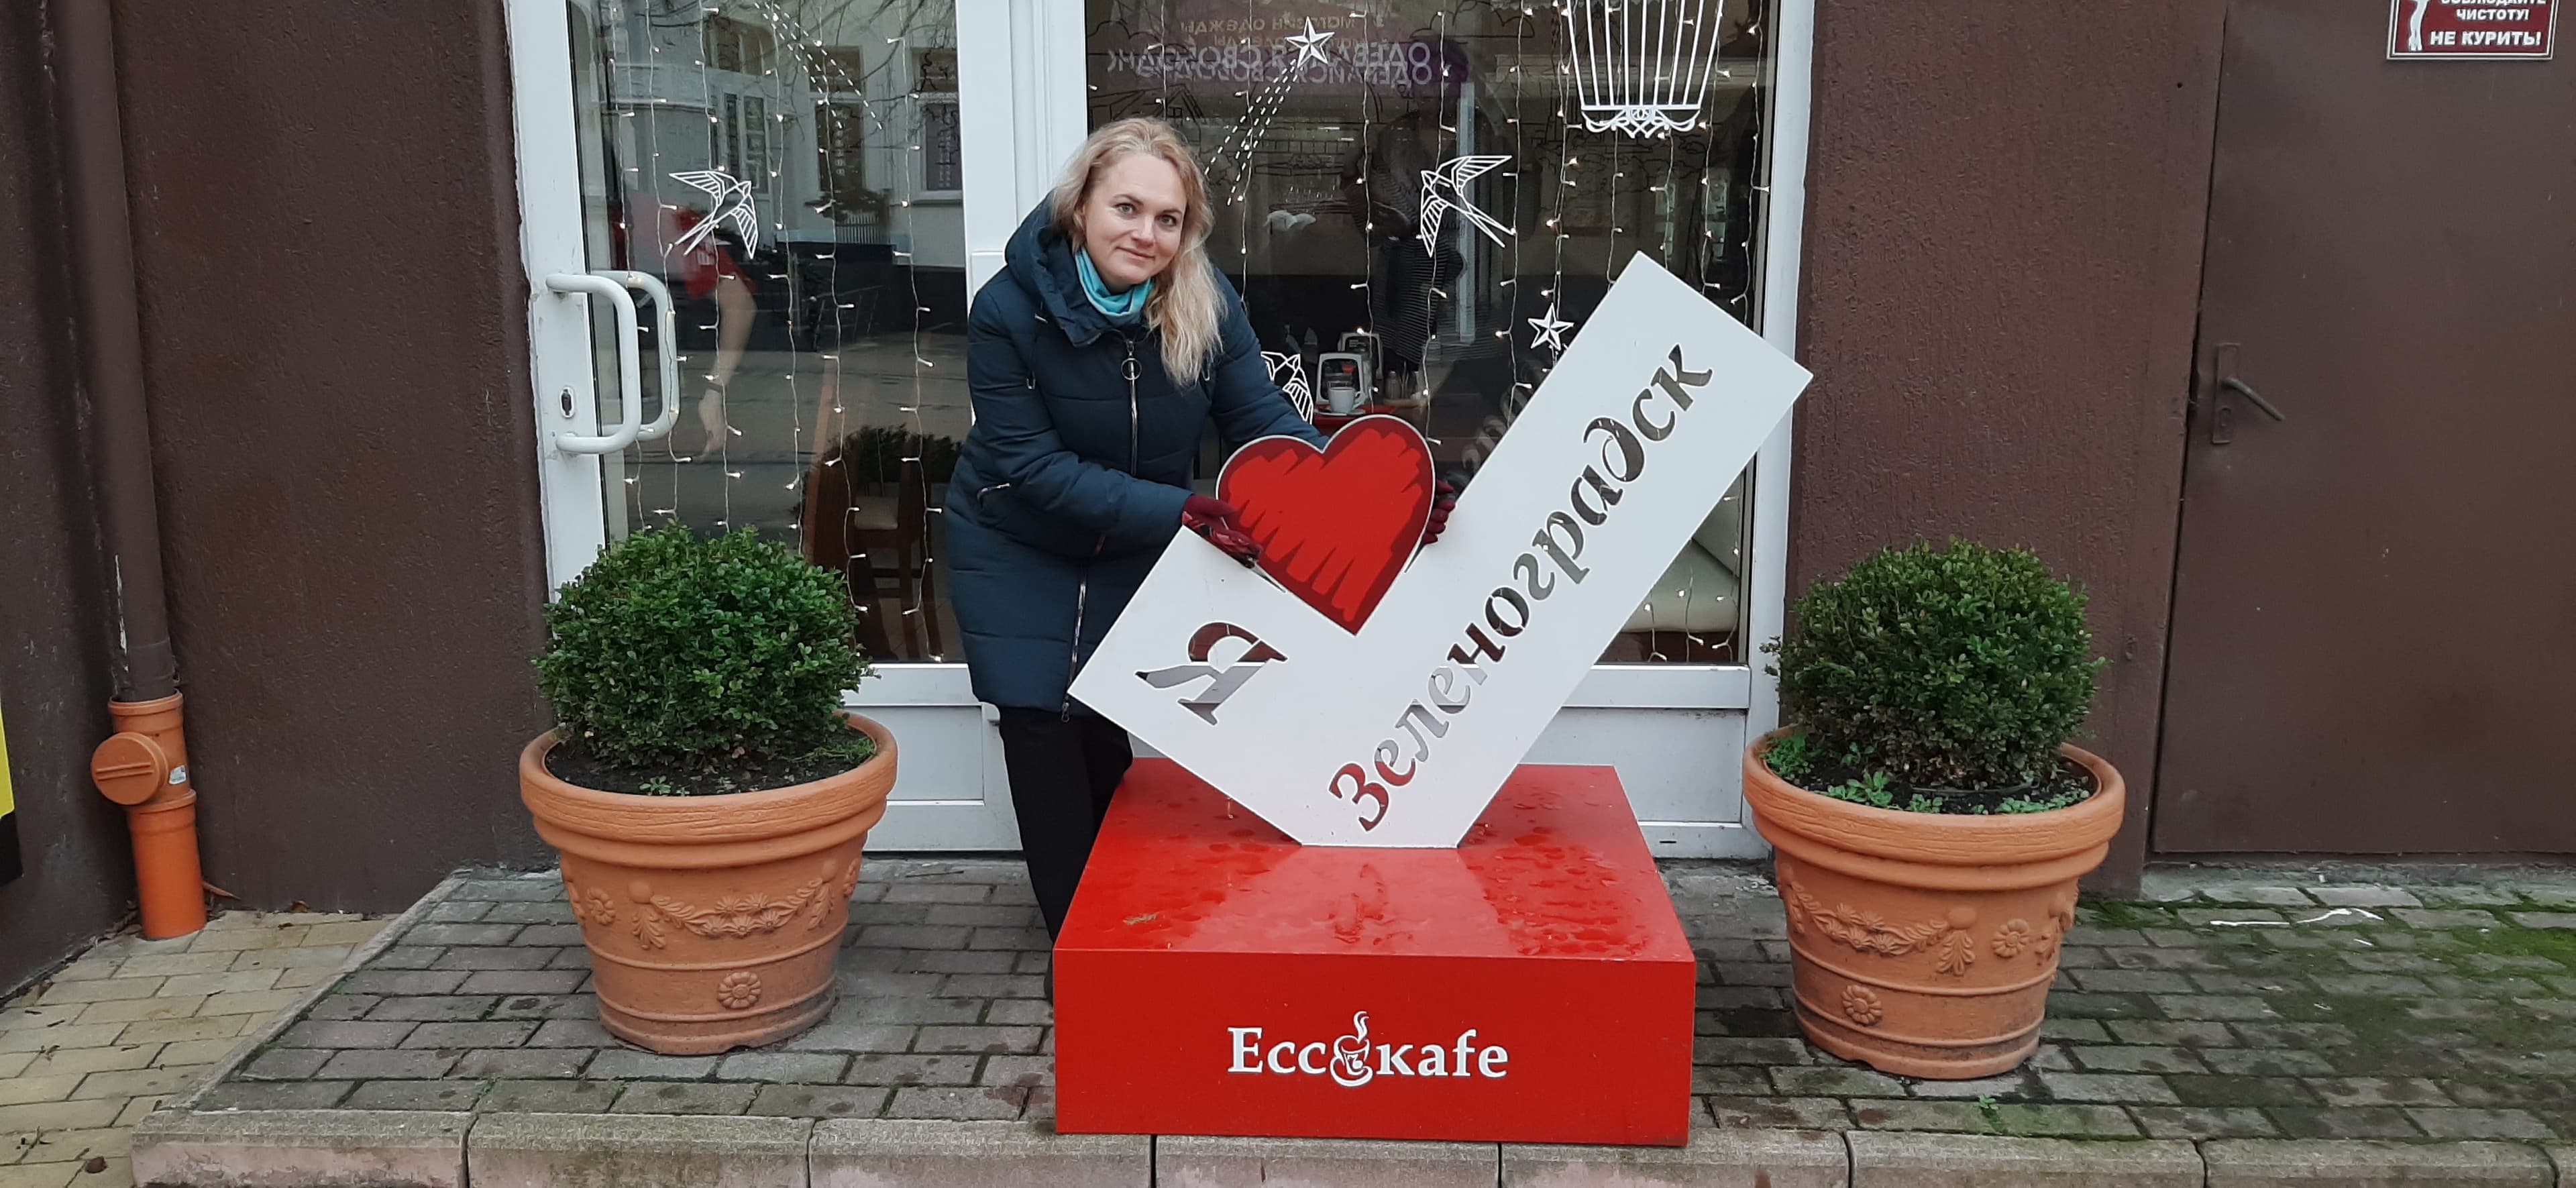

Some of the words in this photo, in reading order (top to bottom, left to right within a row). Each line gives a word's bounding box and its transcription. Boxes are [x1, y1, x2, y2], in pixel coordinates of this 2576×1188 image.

[2430, 31, 2457, 46] НЕ
[2461, 31, 2542, 46] КУРИТЬ!
[2456, 9, 2530, 21] ЧИСТОТУ!
[1329, 343, 1713, 831] Зеленоградск
[1134, 622, 1287, 726] Я
